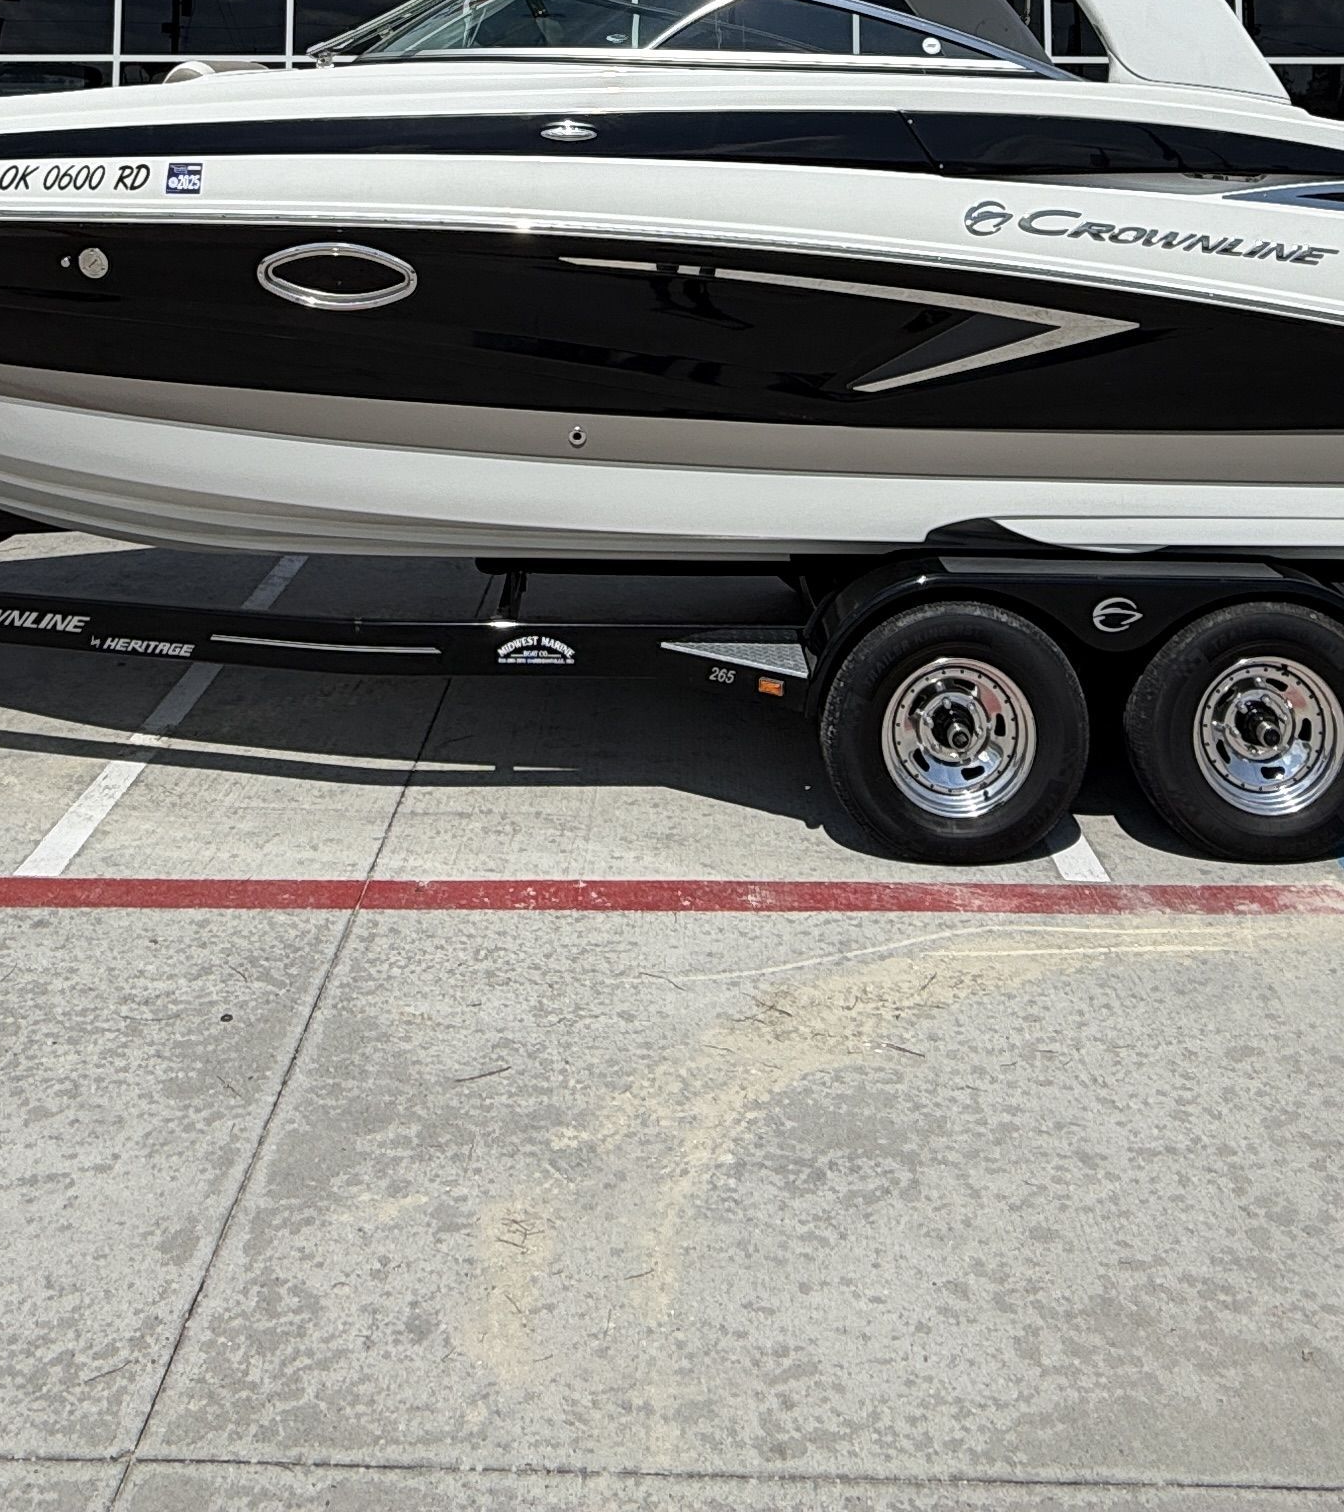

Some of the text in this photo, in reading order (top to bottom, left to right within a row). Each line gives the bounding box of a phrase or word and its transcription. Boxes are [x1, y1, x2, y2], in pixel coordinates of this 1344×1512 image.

[43, 164, 106, 191] 0600
[113, 163, 151, 191] RD
[177, 174, 201, 190] 2025
[1018, 210, 1339, 266] CROWNLINE
[103, 637, 195, 657] HERITAGE
[497, 635, 575, 659] MIDWEST MARINE
[709, 666, 736, 684] 265
